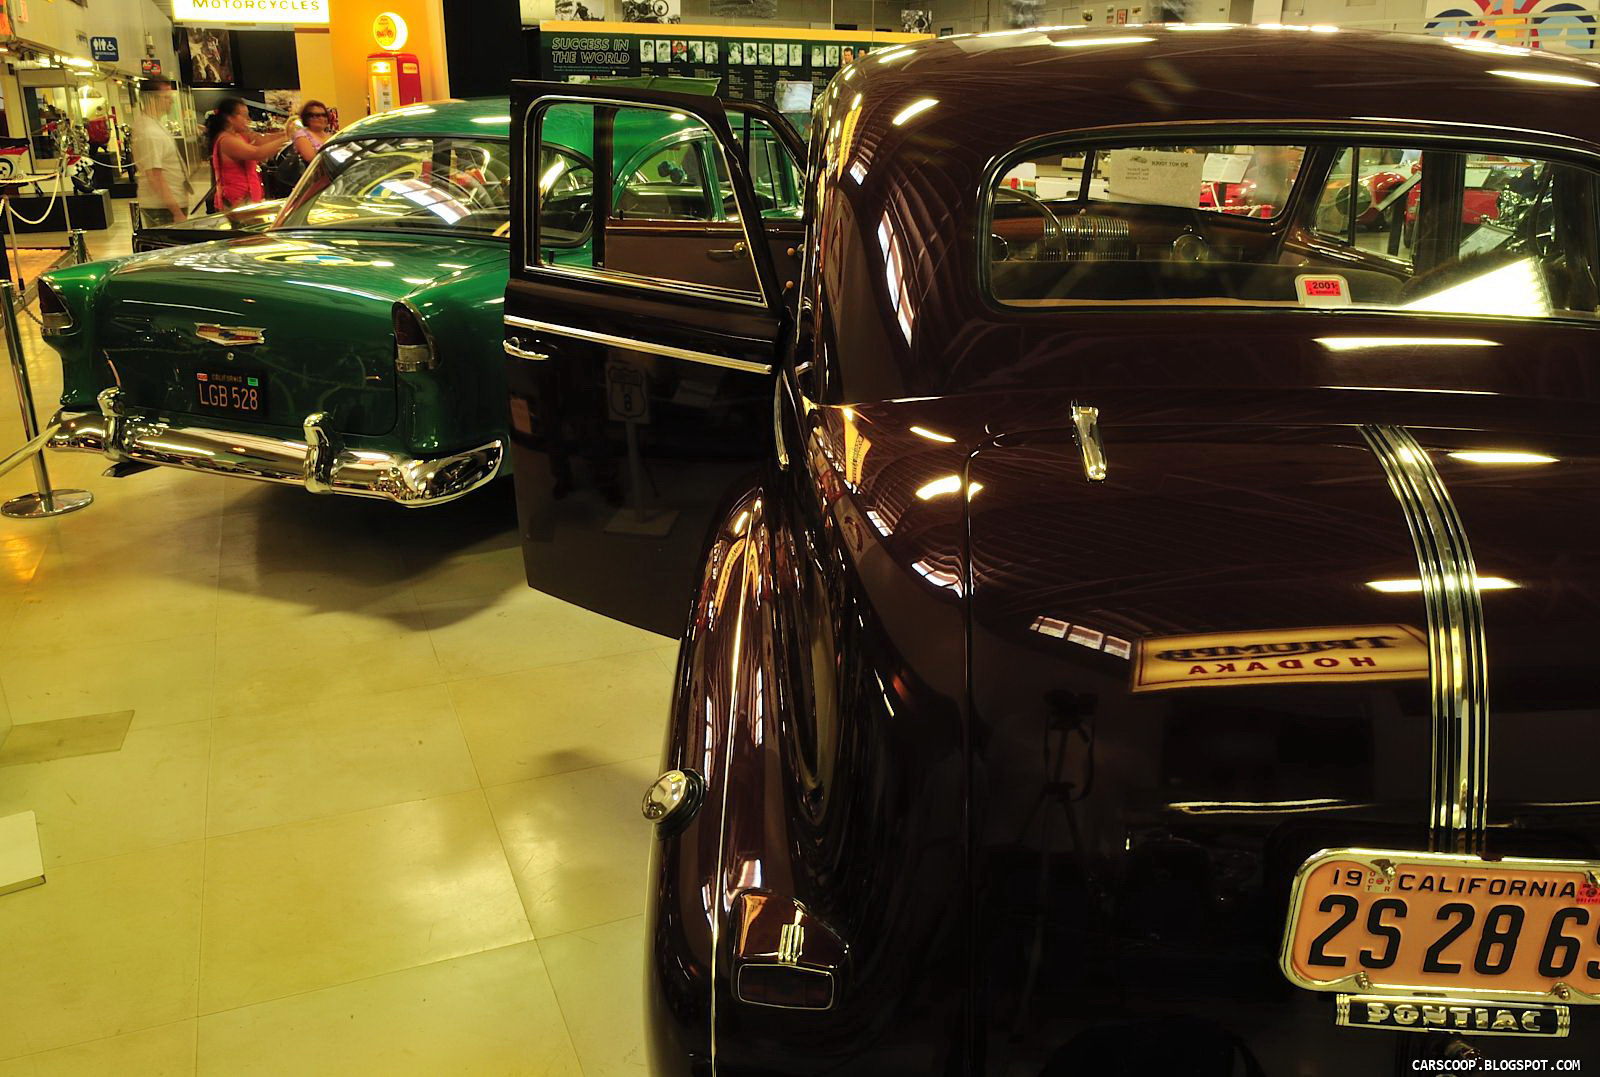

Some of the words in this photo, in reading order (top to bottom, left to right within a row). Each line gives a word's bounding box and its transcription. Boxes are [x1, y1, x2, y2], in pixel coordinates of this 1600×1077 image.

[193, 0, 320, 11] MOTORCYCLES
[551, 37, 610, 51] SUCCESS
[613, 39, 630, 52] IN
[552, 51, 577, 64] THE
[580, 52, 631, 65] WORLD
[1312, 281, 1337, 289] 2001
[199, 383, 229, 407] LGB
[231, 386, 259, 410] 528
[1333, 869, 1363, 887] 19
[1398, 873, 1576, 898] CALIFORNIA
[1422, 903, 1526, 976] 28
[1538, 907, 1600, 980] 6
[1366, 1002, 1542, 1032] PONTIAC
